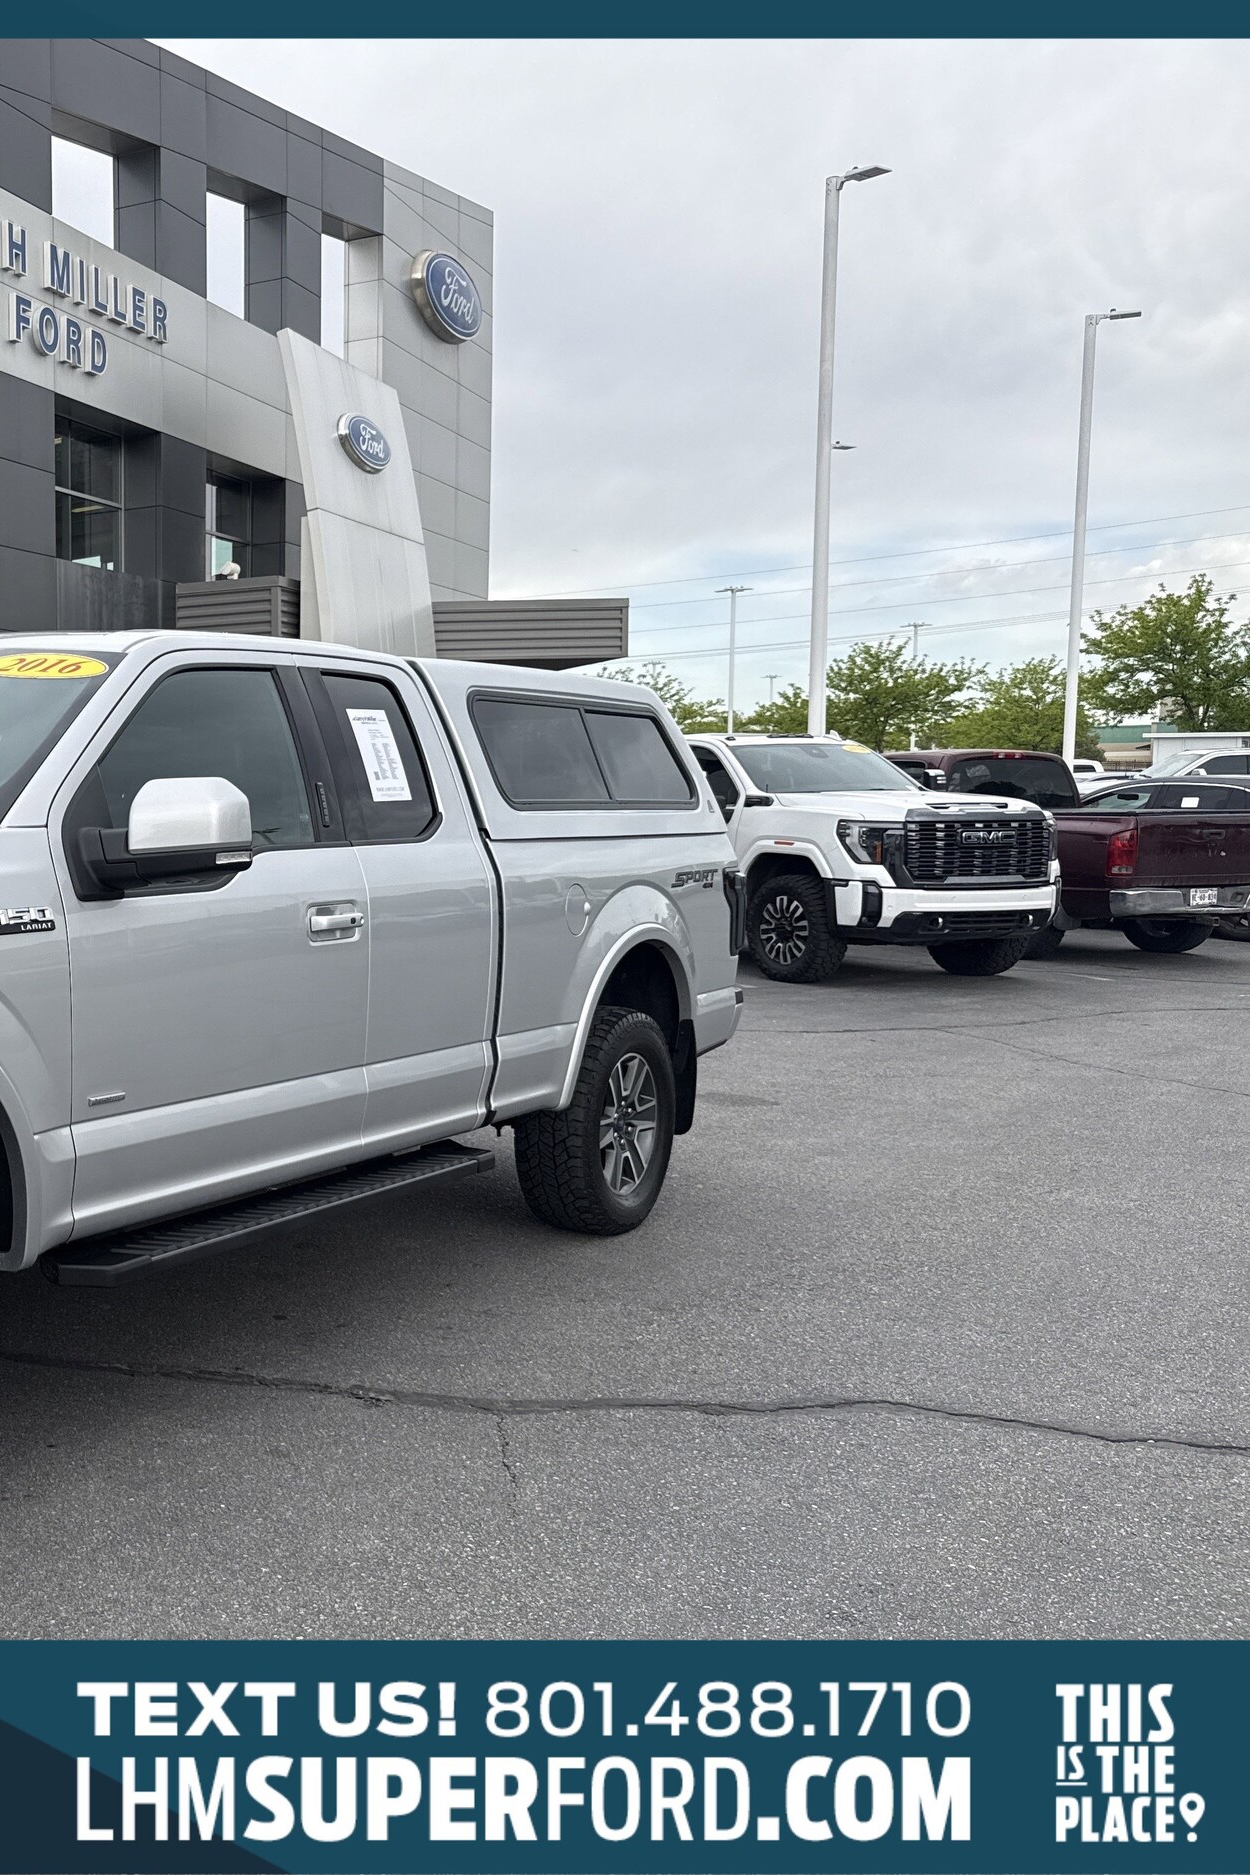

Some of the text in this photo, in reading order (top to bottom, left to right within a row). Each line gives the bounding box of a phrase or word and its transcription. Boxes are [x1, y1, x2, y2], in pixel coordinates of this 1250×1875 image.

[2, 219, 27, 277] H
[44, 241, 168, 344] MILLER
[440, 266, 475, 325] Ford
[9, 292, 108, 375] FORD
[359, 423, 386, 459] Ford
[962, 831, 1016, 844] GMC
[671, 868, 718, 888] SPORT
[21, 922, 52, 931] LARIAT
